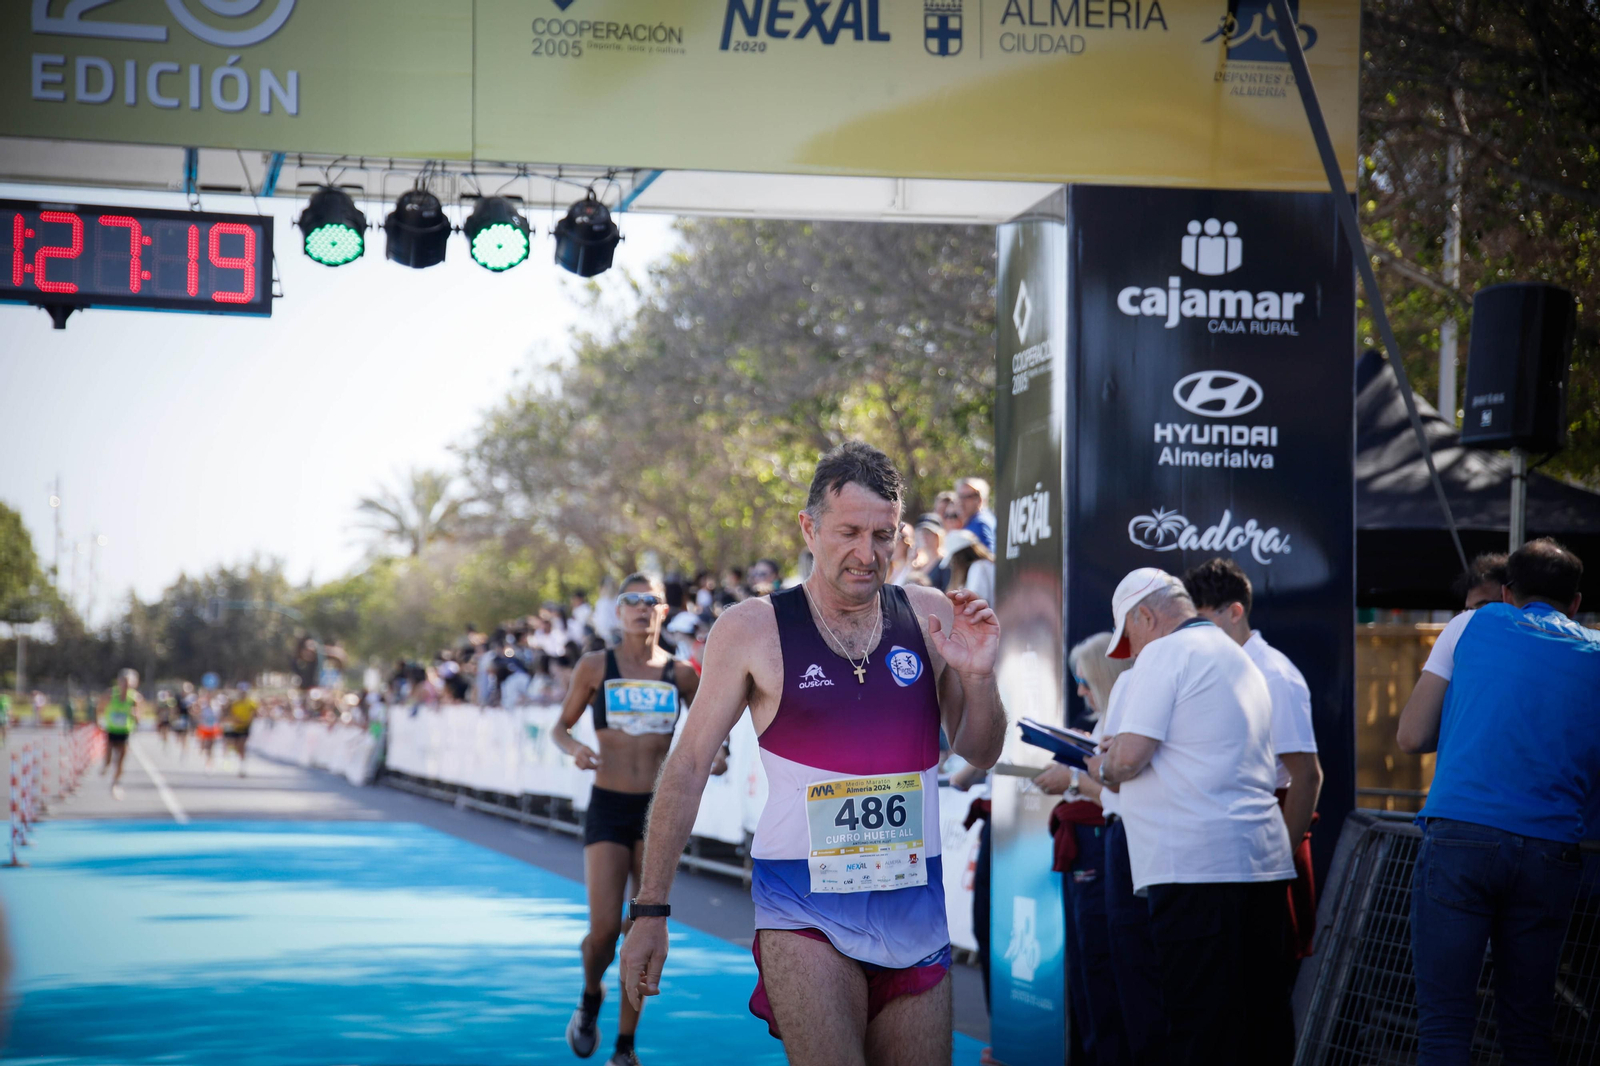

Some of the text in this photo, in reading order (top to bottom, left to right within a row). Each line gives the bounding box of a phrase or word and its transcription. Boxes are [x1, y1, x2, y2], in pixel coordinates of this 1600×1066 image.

[532, 17, 683, 44] COOPERACIÓN
[719, 0, 891, 50] NEXAL
[532, 37, 582, 57] 2005
[733, 41, 767, 52] 2020
[999, 32, 1086, 55] CIUDAD
[31, 52, 298, 116] EDICIÓN
[13, 211, 256, 304] 1:27:19
[1117, 276, 1305, 328] cajamar
[1207, 320, 1299, 336] CAJA RURAL
[1154, 423, 1278, 447] HYUNDAI
[1158, 448, 1274, 469] Almerialva
[799, 680, 835, 689] austral
[614, 687, 670, 706] 1637
[834, 794, 907, 830] 486
[826, 828, 913, 844] CURRO HUETE ALL
[846, 863, 867, 872] NEXAL
